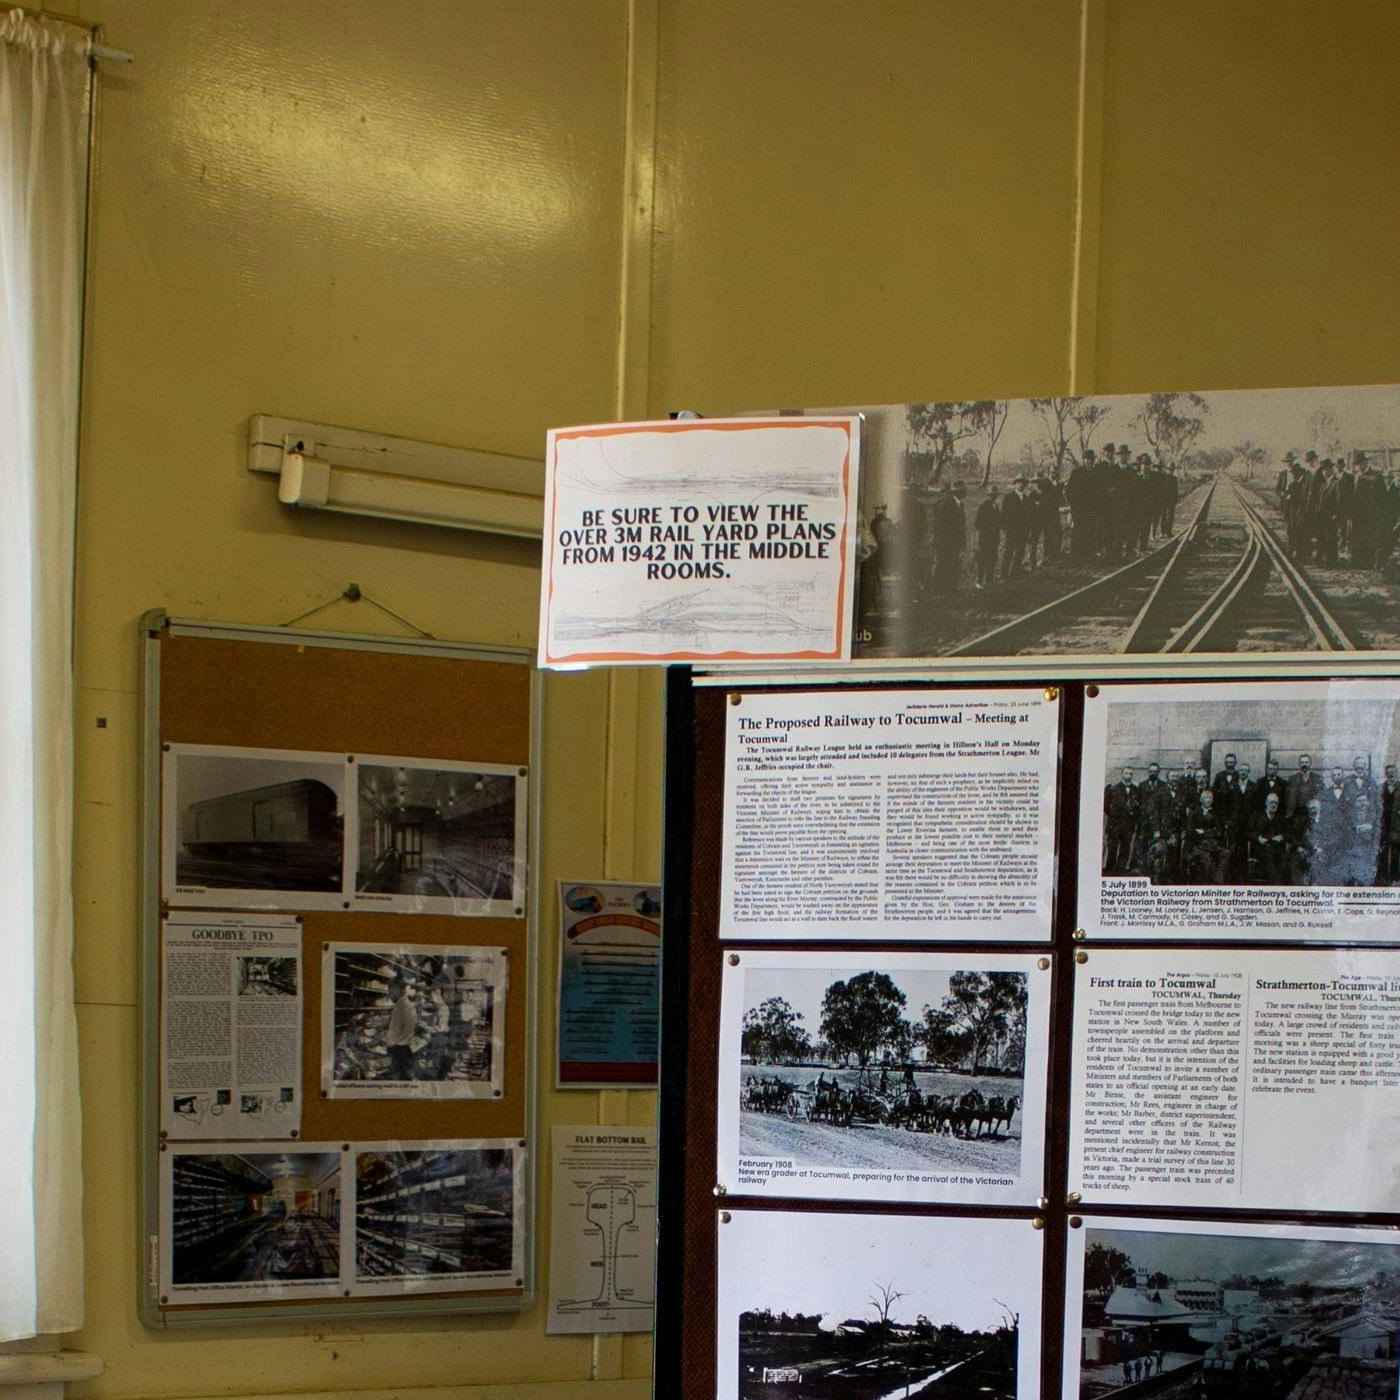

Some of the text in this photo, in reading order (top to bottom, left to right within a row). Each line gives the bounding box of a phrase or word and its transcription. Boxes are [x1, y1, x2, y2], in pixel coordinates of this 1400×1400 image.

[582, 504, 809, 527] BE SURE TO VIEW THE
[559, 523, 836, 547] OVER 3M RAIL YARD PLANS
[562, 542, 830, 565] FROM 1942 IN THE MIDDLE
[647, 562, 731, 580] ROOMS.
[738, 717, 762, 731] The
[766, 716, 820, 732] Proposed
[824, 714, 875, 731] Railway
[879, 715, 892, 726] to
[896, 712, 963, 726] Tocumwal
[975, 714, 1016, 727] Meeting
[1019, 715, 1029, 723] at
[737, 733, 788, 745] Tocumwal
[192, 929, 273, 942] GOODBYE TPO
[1090, 977, 1216, 989] First train to Tocumwal
[1256, 979, 1386, 993] Strathmerton-Tocumwal
[575, 1136, 594, 1144] FLAT
[596, 1136, 629, 1144] BOTTOM
[738, 1159, 793, 1170] February 1908
